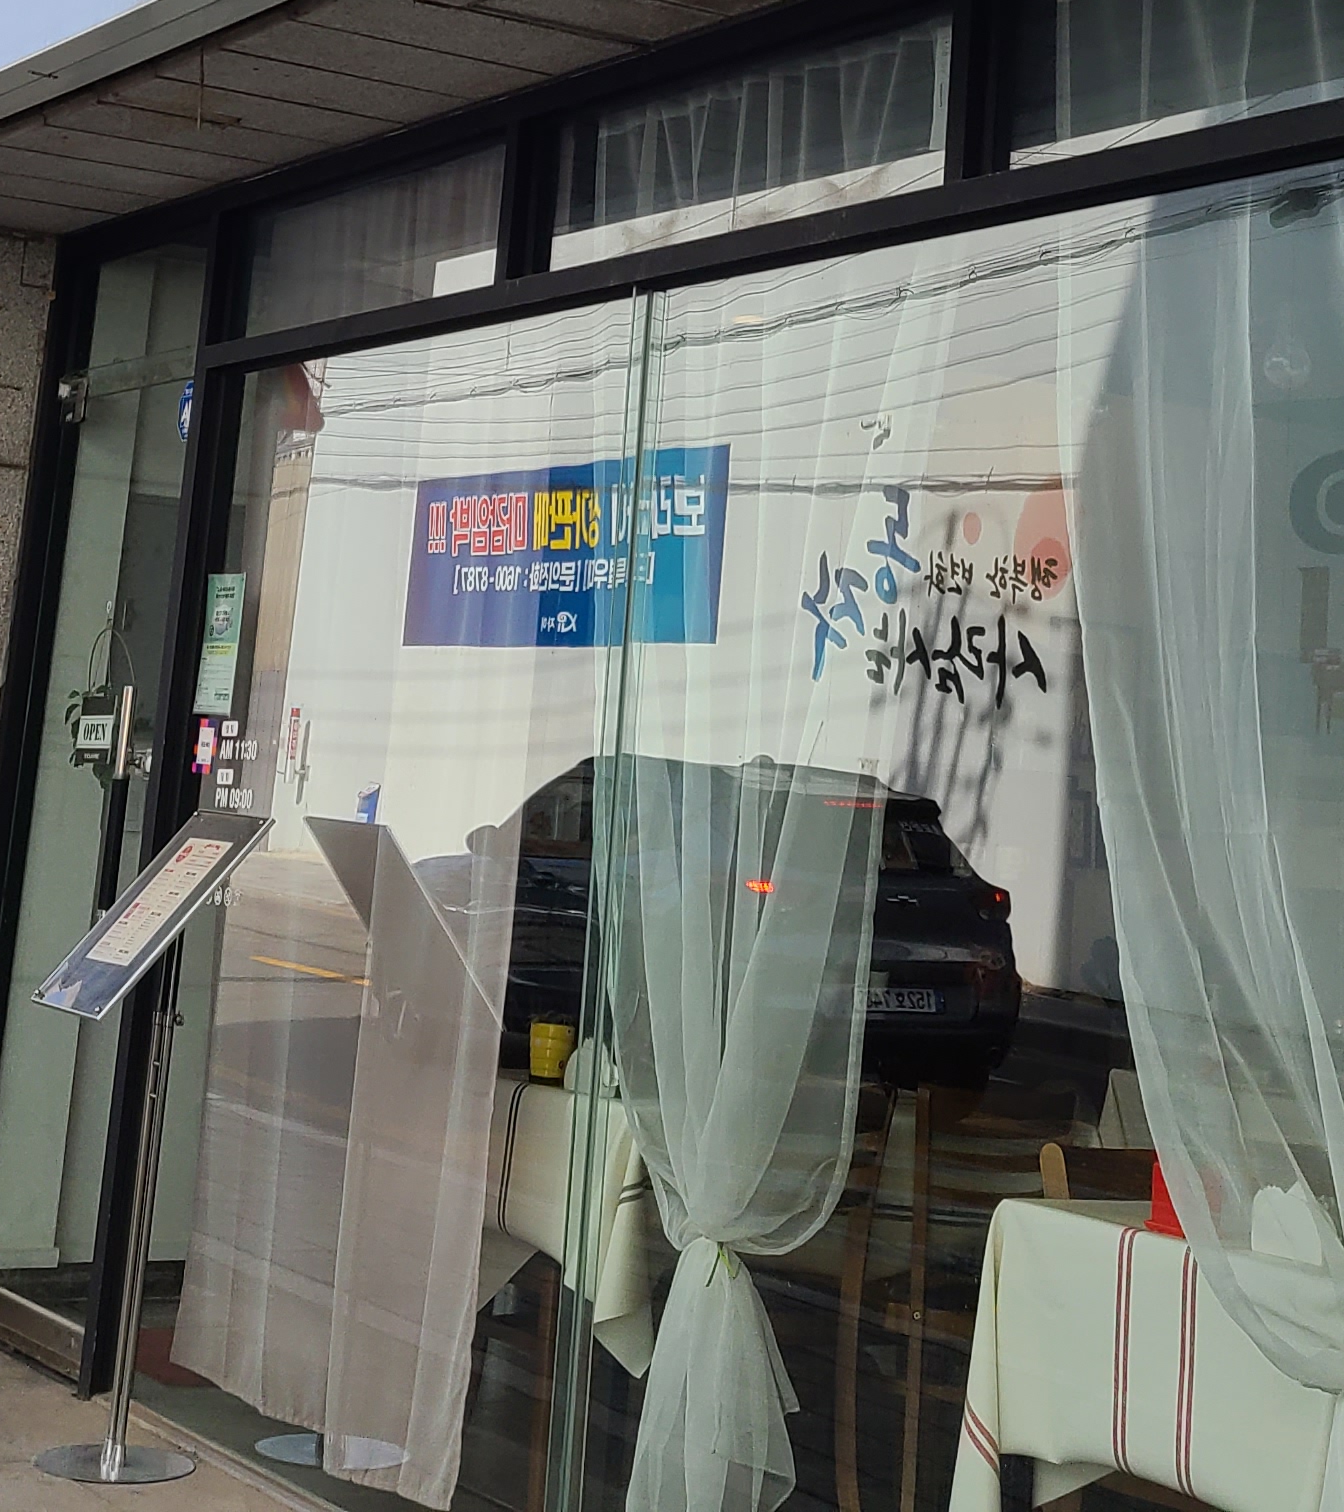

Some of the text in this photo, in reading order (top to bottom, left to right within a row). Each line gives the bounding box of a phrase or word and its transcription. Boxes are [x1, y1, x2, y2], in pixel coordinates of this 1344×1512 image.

[83, 722, 108, 741] OPEN
[220, 739, 258, 761] AM 11:30
[215, 787, 253, 809] PM 09:00
